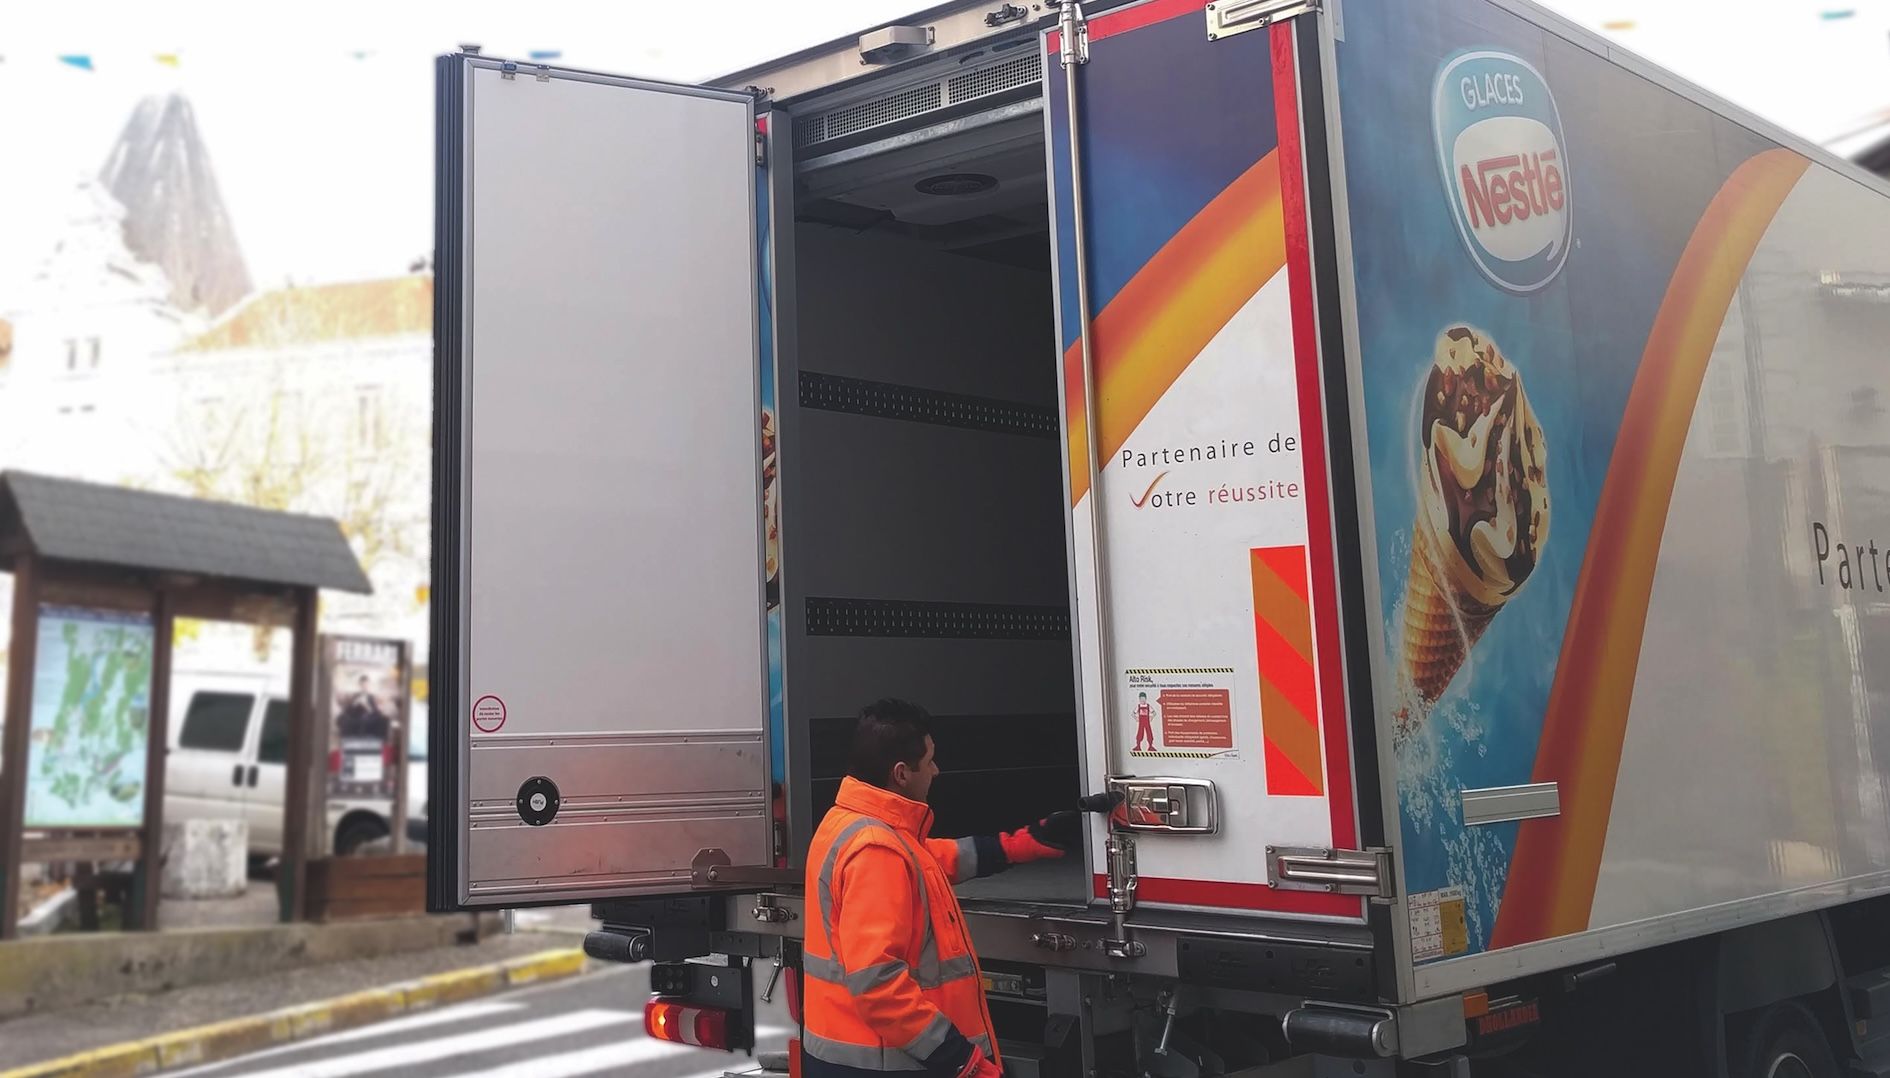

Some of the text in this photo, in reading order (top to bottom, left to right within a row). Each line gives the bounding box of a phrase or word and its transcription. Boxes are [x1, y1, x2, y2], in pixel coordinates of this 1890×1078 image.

[1461, 72, 1523, 110] GLACES
[1461, 149, 1564, 229] Nestlé
[1122, 433, 1297, 468] Partenaire de
[1208, 480, 1299, 504] réussite
